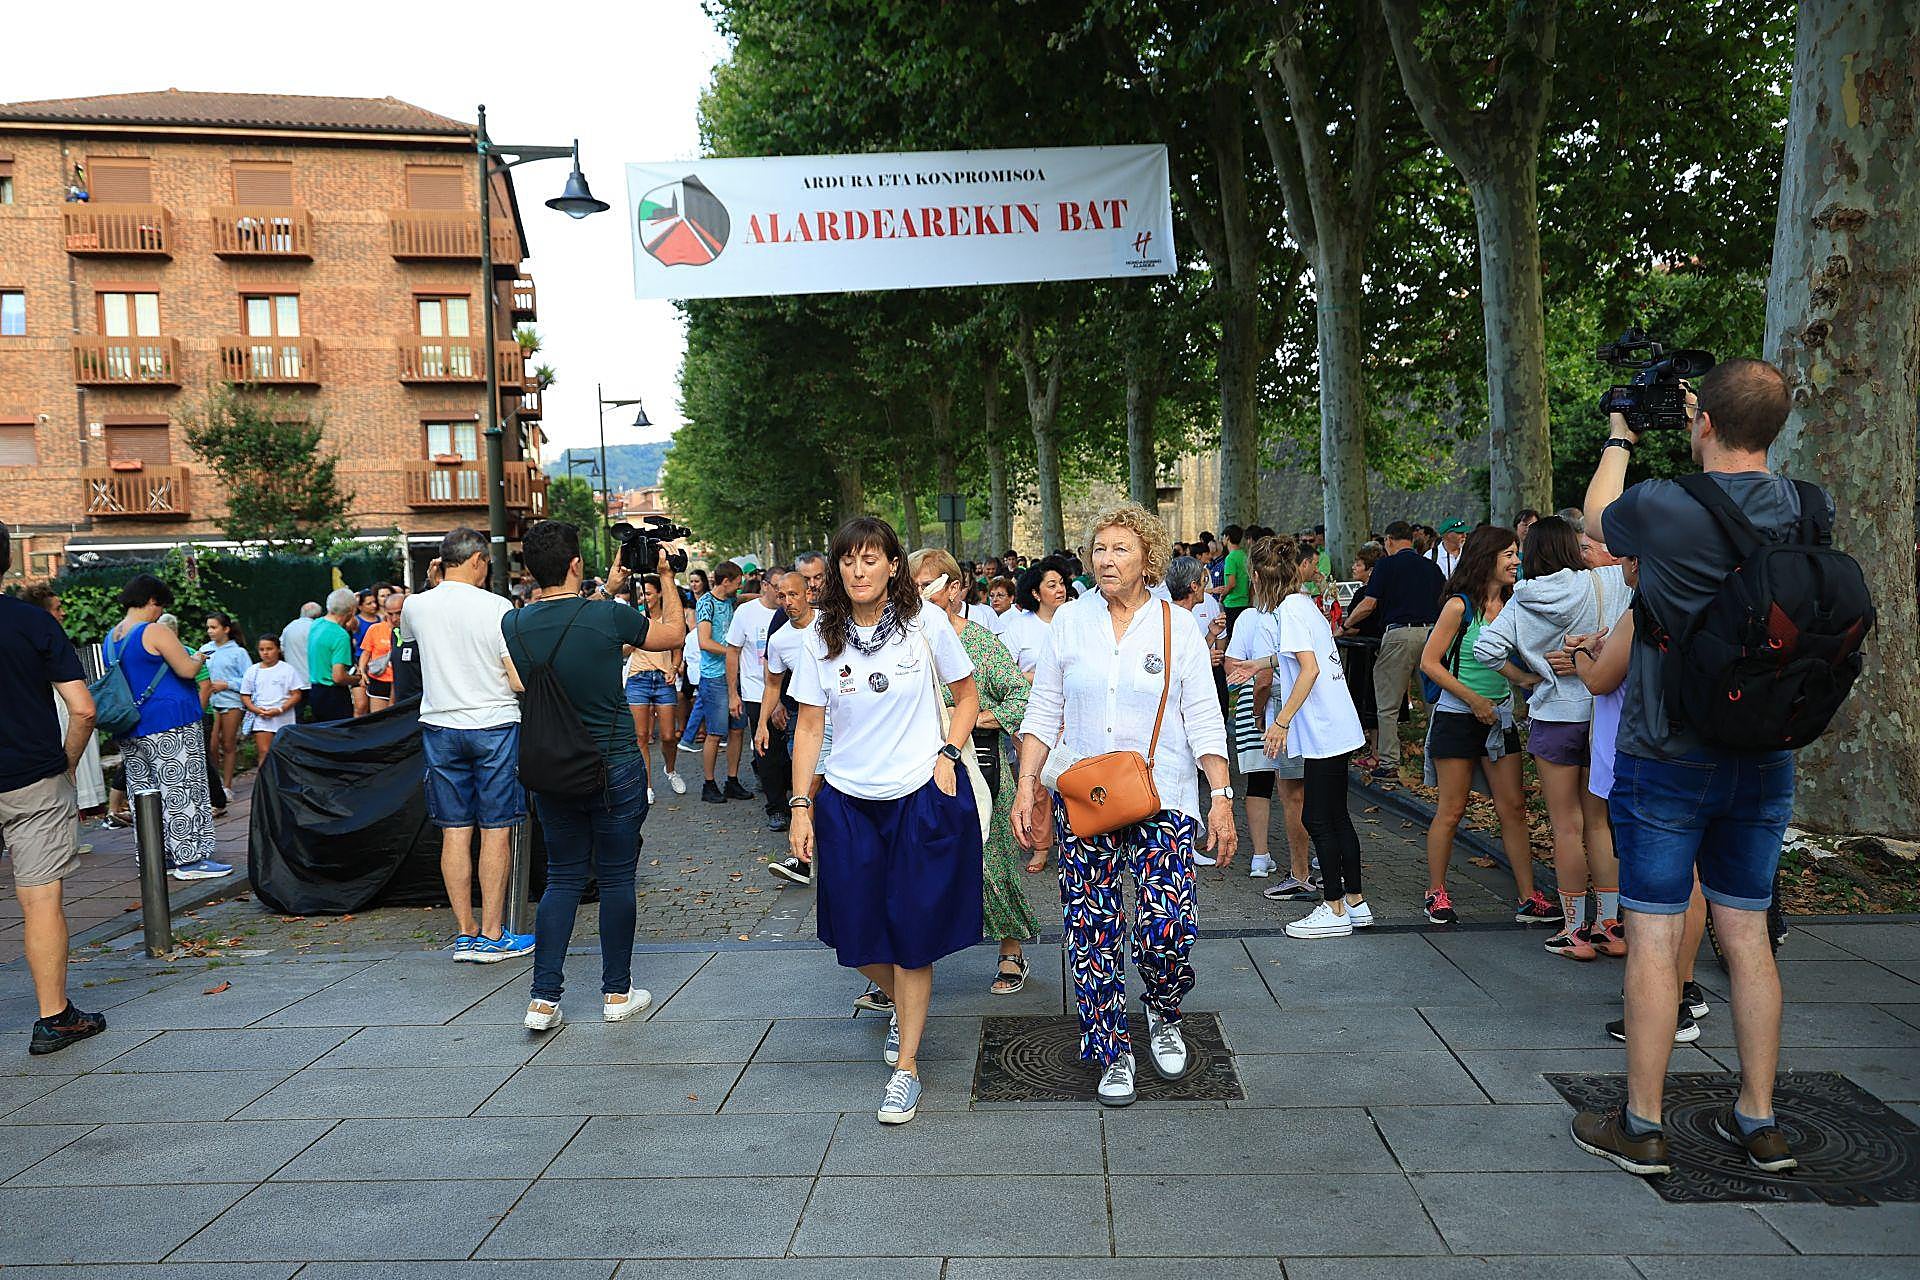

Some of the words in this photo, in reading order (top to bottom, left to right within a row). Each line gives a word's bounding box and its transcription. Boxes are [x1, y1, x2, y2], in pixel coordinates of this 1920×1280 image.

[803, 174, 873, 189] ARDURA
[878, 173, 911, 187] ETA
[916, 168, 1046, 185] KONPROMISOA
[745, 202, 1040, 244] ALARDEAREKIN
[1057, 199, 1129, 232] BAT
